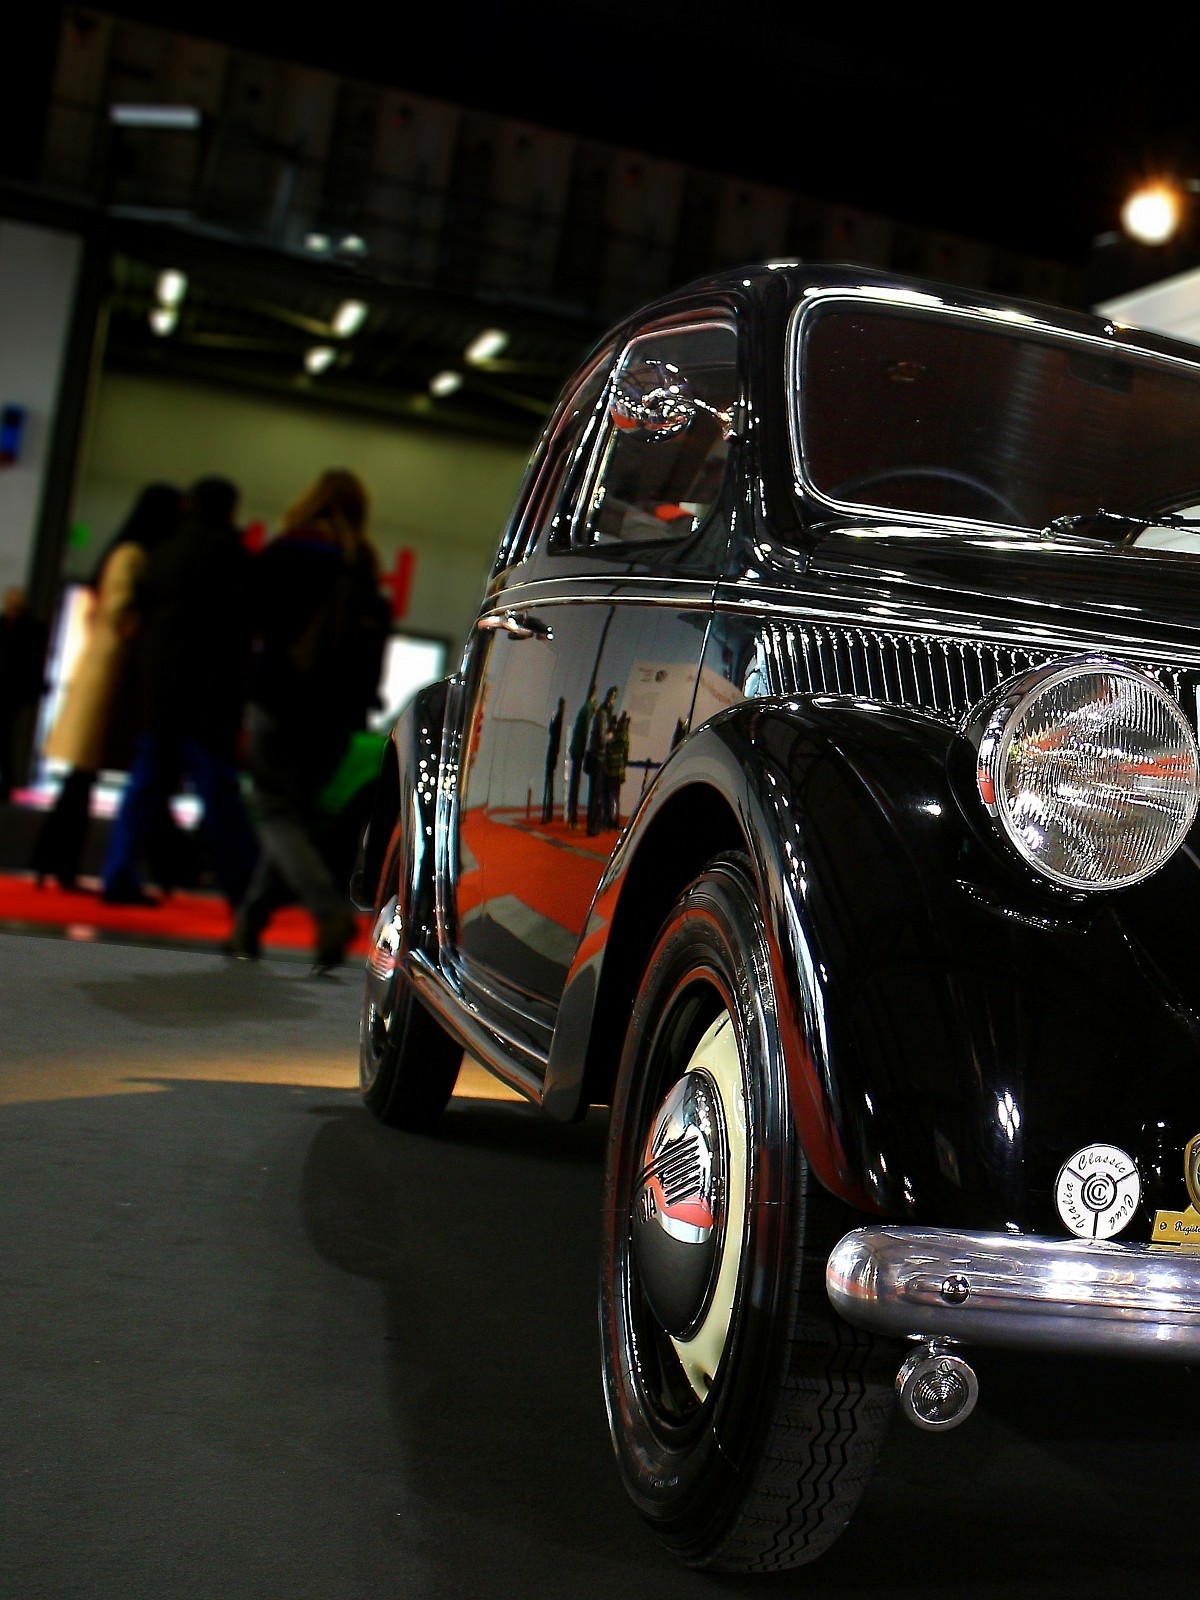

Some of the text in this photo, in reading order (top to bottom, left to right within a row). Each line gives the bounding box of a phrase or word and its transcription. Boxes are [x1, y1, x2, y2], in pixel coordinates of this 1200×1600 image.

[1078, 1152, 1126, 1174] Classic
[1062, 1182, 1087, 1228] Italia
[1108, 1194, 1134, 1230] Club
